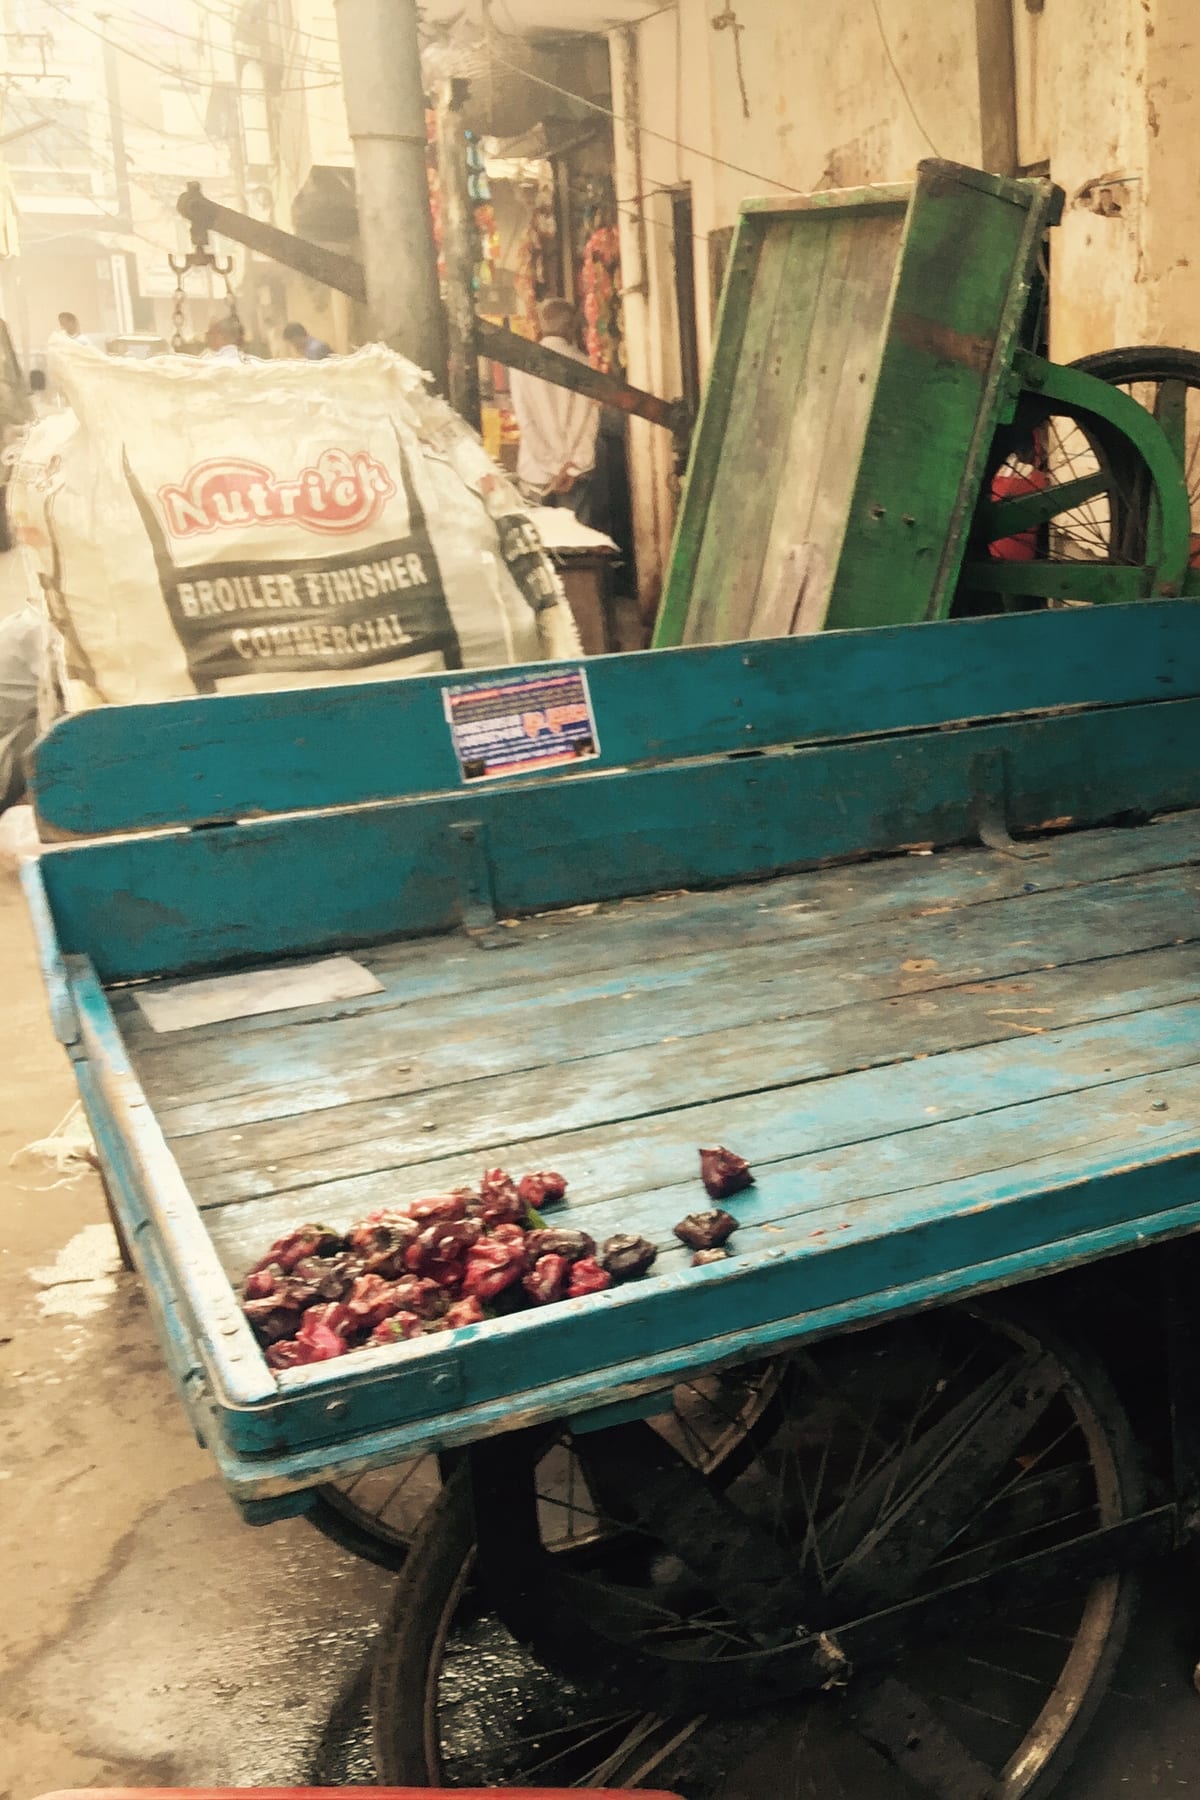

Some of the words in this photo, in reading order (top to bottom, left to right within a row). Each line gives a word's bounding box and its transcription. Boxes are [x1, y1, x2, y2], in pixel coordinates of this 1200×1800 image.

[178, 574, 302, 617] BROILER
[303, 553, 428, 605] FINISHER
[233, 614, 412, 659] COMMERCIAL
